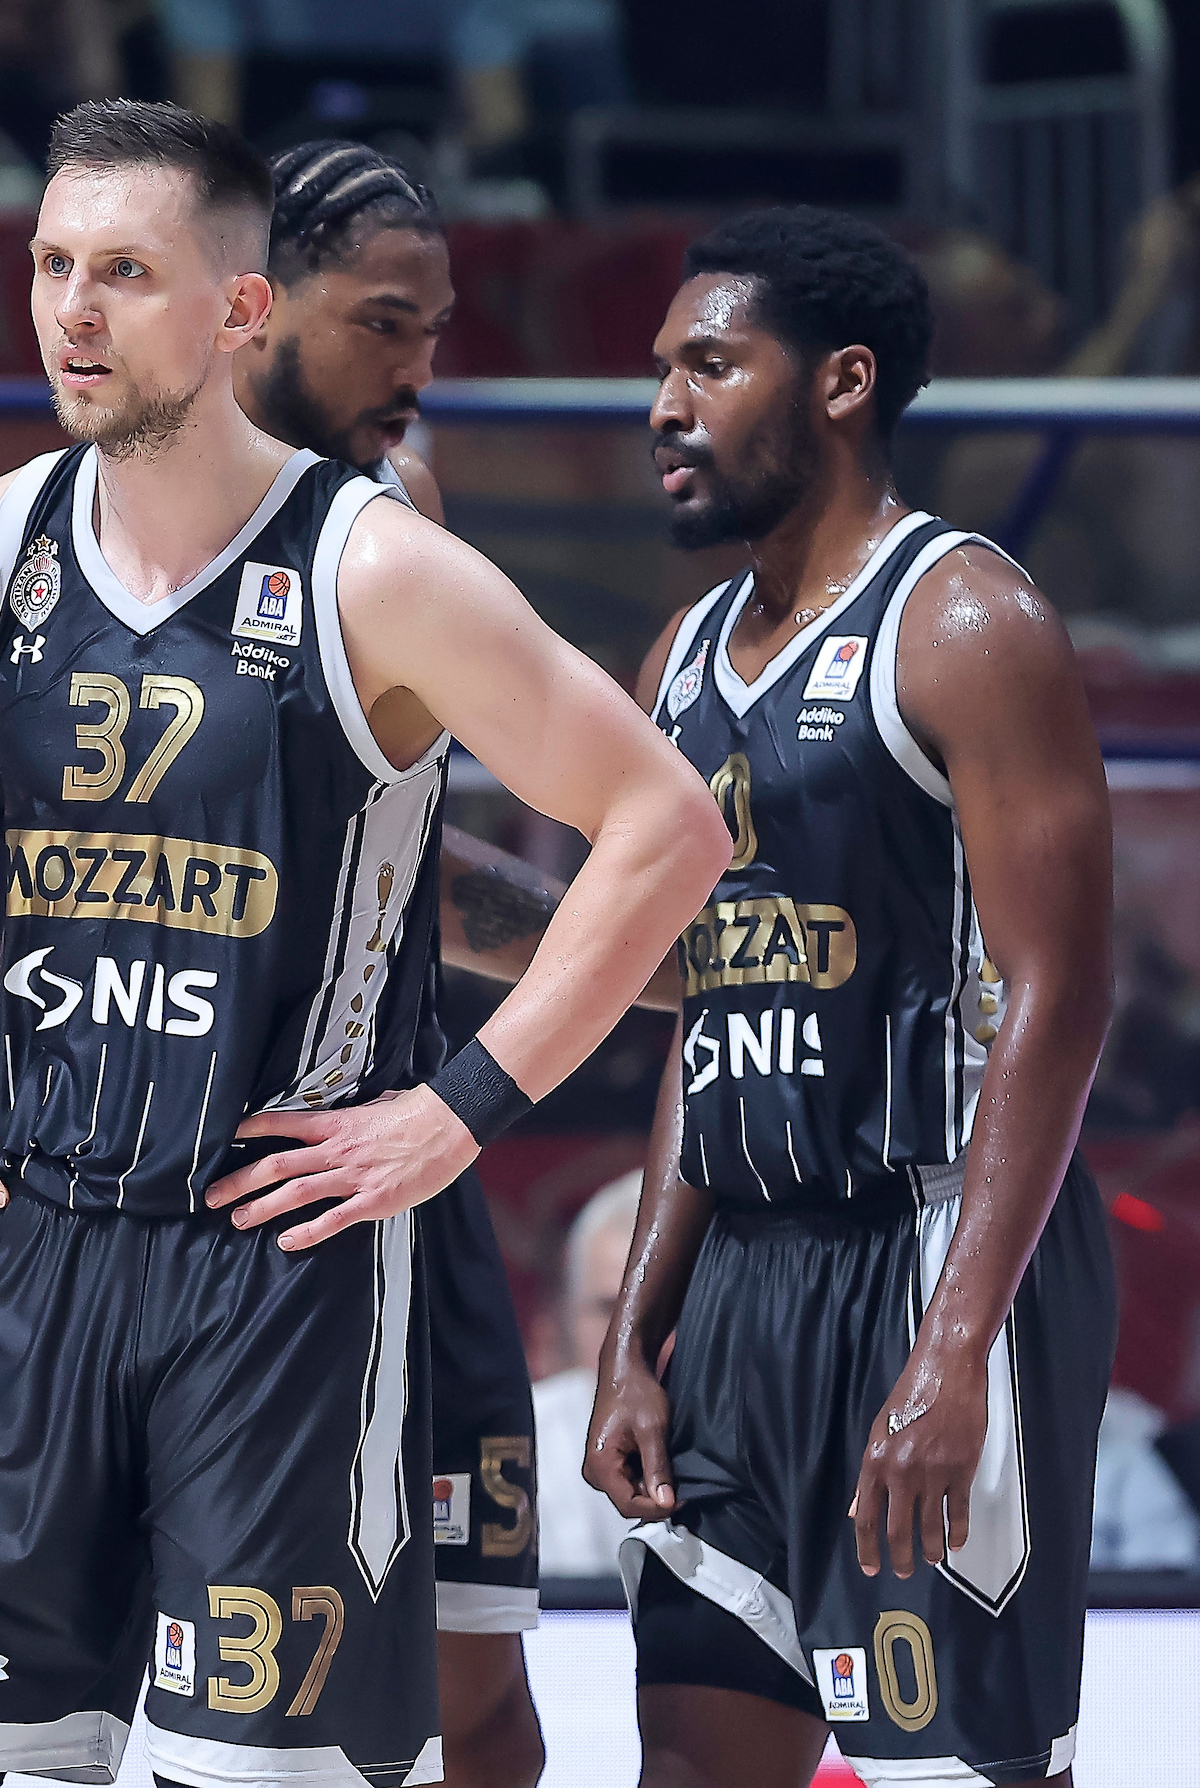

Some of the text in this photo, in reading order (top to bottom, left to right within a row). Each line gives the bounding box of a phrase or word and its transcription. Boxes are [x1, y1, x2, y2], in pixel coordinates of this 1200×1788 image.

[259, 595, 284, 618] ABA
[241, 617, 297, 635] ADMIRAL
[230, 640, 291, 669] Addiko
[235, 658, 277, 682] Bank
[796, 706, 845, 725] Addiko
[62, 672, 205, 803] 37
[797, 723, 835, 742] Bank
[91, 955, 218, 1037] NIS
[480, 1436, 531, 1557] 5
[206, 1585, 345, 1717] 37
[160, 1668, 192, 1685] ADMIRAL
[873, 1608, 939, 1733] 0
[829, 1701, 865, 1709] ADMIRAL
